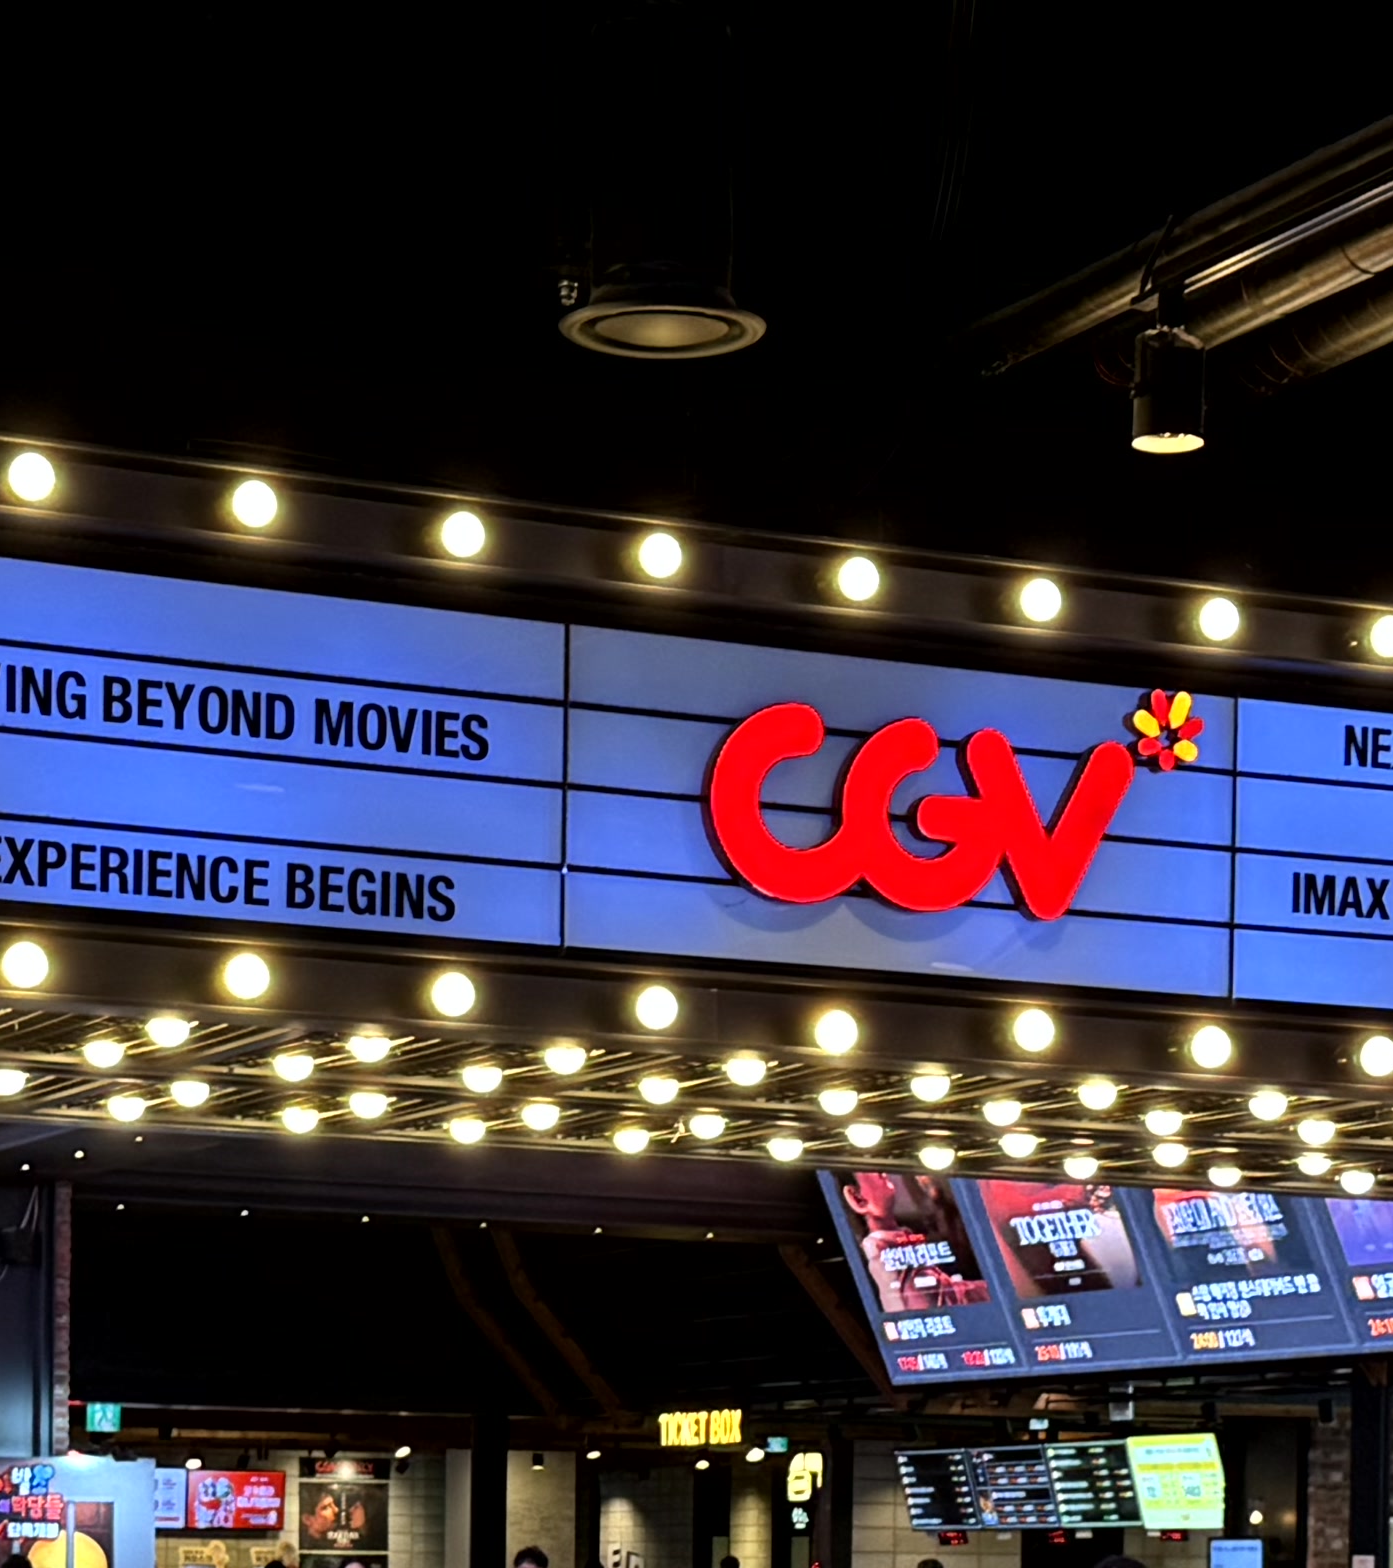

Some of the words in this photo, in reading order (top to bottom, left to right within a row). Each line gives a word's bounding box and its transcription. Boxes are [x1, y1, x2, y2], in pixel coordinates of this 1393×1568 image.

[102, 675, 295, 741] BEYOND
[313, 697, 491, 762] MOVIES
[710, 702, 1136, 920] CGV
[285, 862, 458, 922] BEGINS
[1291, 871, 1391, 921] IMAX
[1010, 1209, 1102, 1246] TOGETHER
[658, 1411, 708, 1446] TICKET
[709, 1408, 742, 1444] BOX
